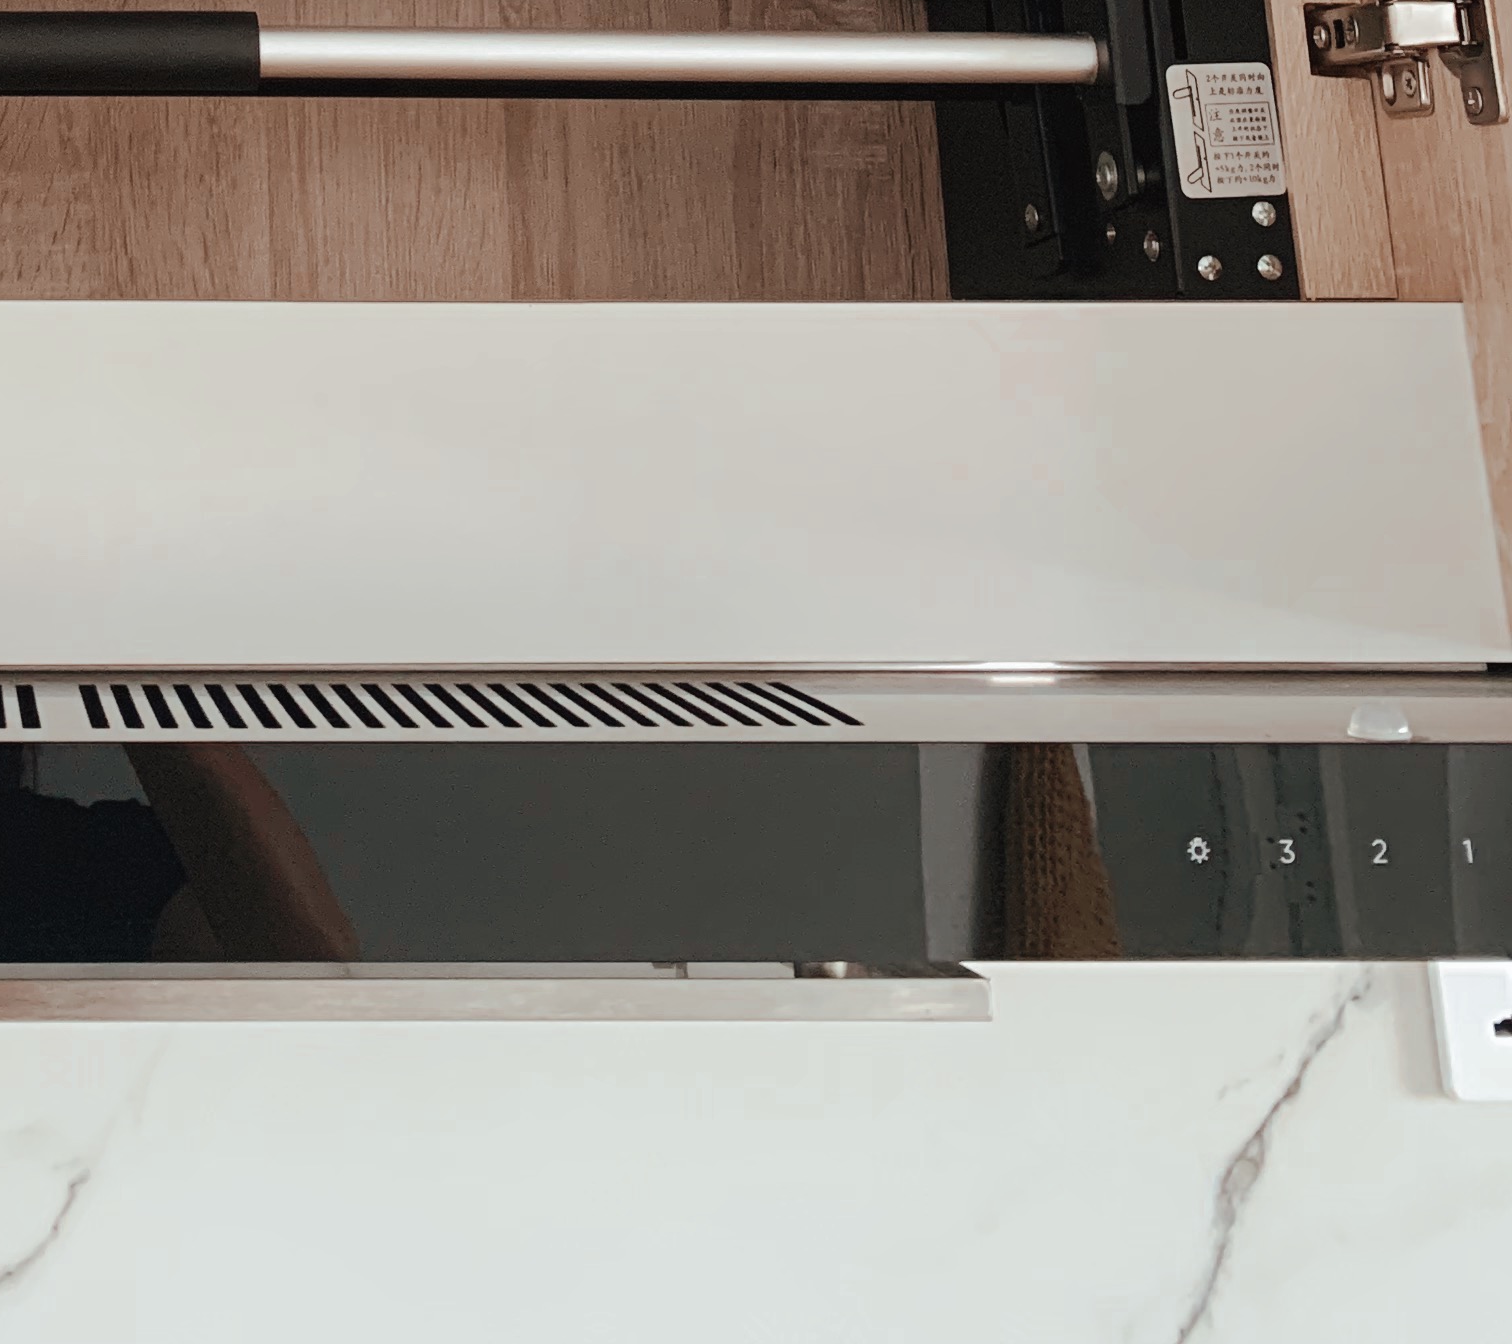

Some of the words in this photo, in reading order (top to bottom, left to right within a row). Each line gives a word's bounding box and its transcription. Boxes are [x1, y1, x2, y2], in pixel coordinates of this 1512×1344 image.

[1278, 838, 1296, 865] 3
[1371, 838, 1389, 865] 2
[1462, 838, 1475, 865] 1
